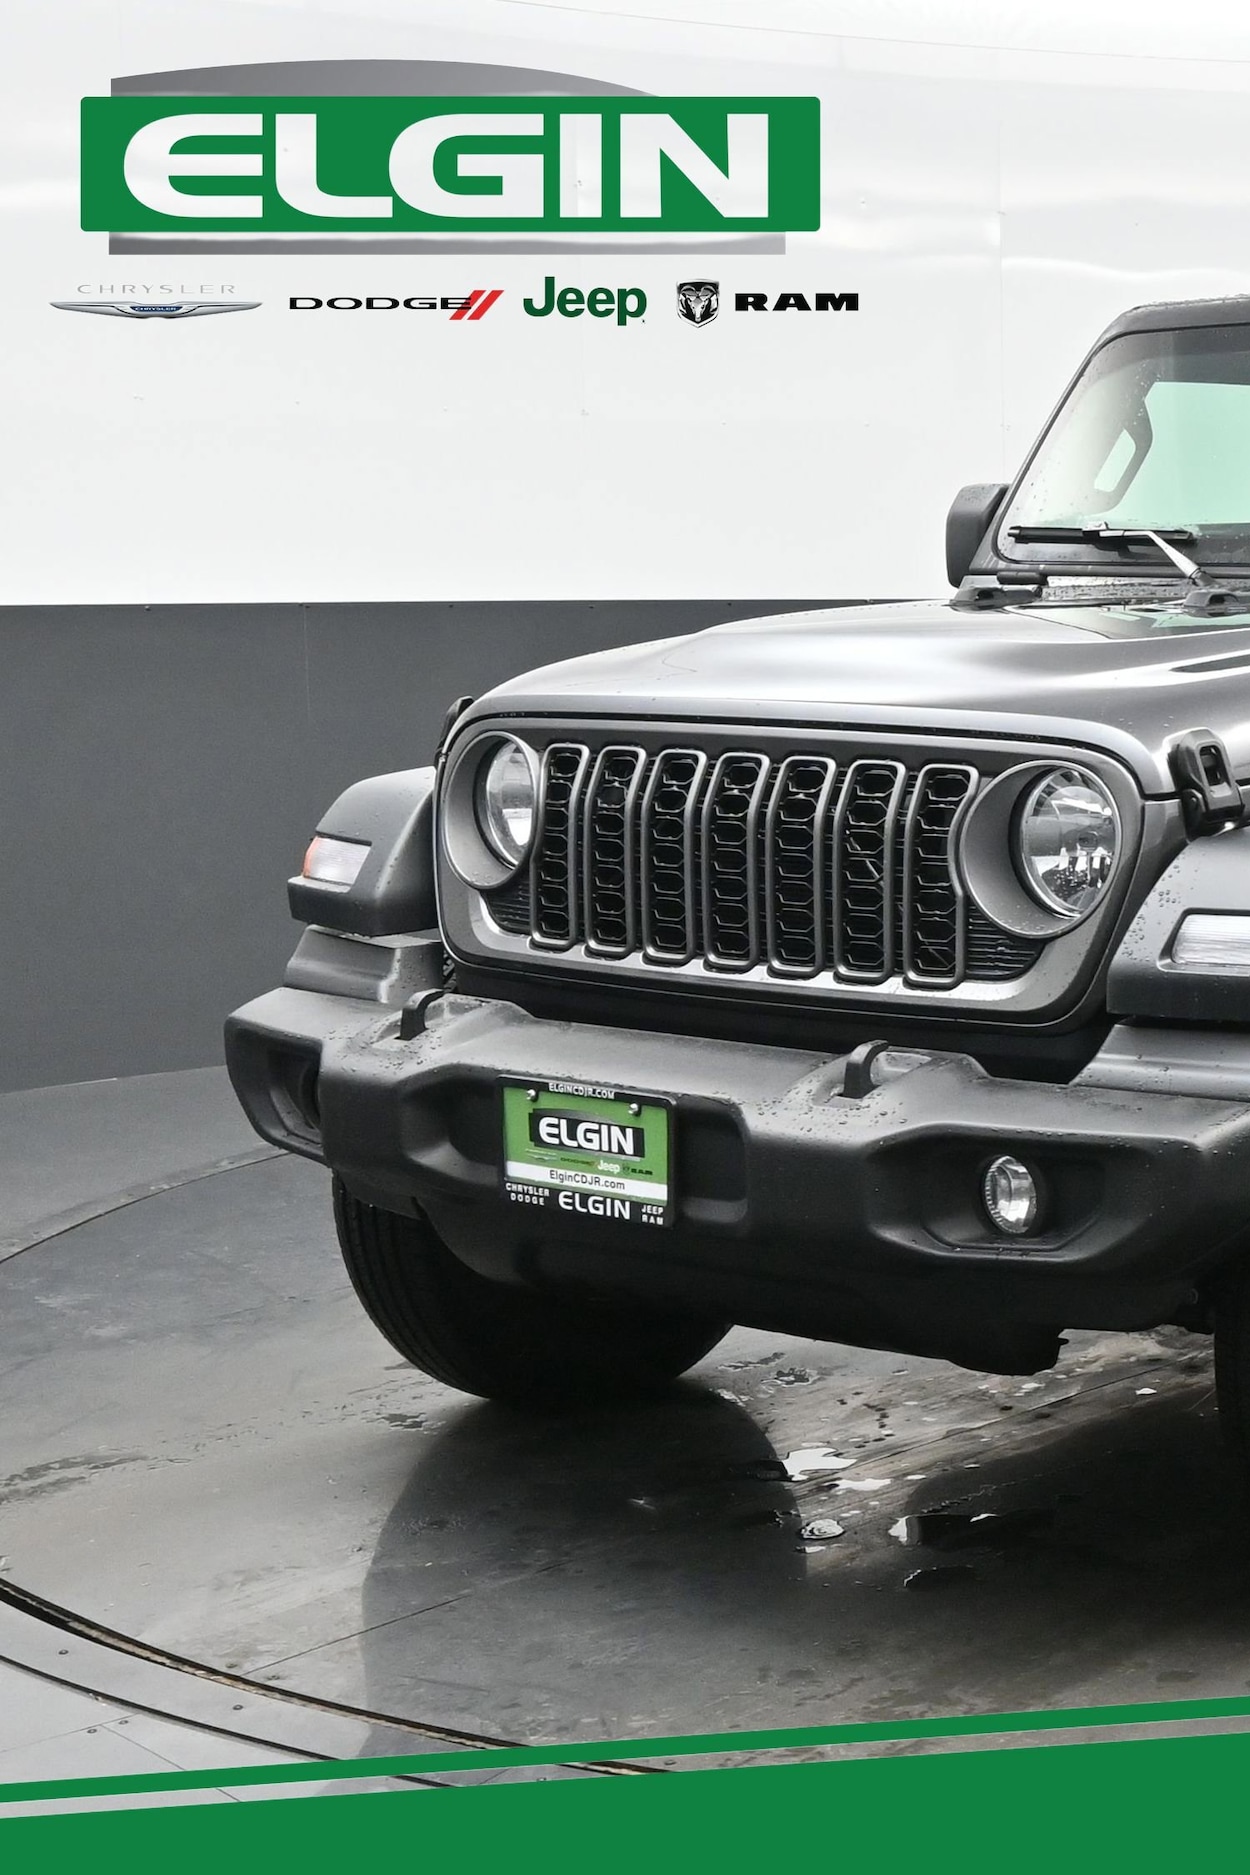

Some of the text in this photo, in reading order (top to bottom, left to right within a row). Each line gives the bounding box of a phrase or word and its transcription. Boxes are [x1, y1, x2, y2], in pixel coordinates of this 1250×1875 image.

[548, 1082, 615, 1100] ELGINCDJR.COM
[538, 1116, 634, 1156] ELGIN
[597, 1160, 620, 1174] Jeep
[549, 1169, 626, 1191] ElginCDJR.com
[505, 1182, 550, 1197] CHRYSLER
[510, 1192, 545, 1206] DODGE
[558, 1190, 630, 1220] ELGIN
[641, 1204, 664, 1215] JEEP
[642, 1214, 664, 1226] RAM
